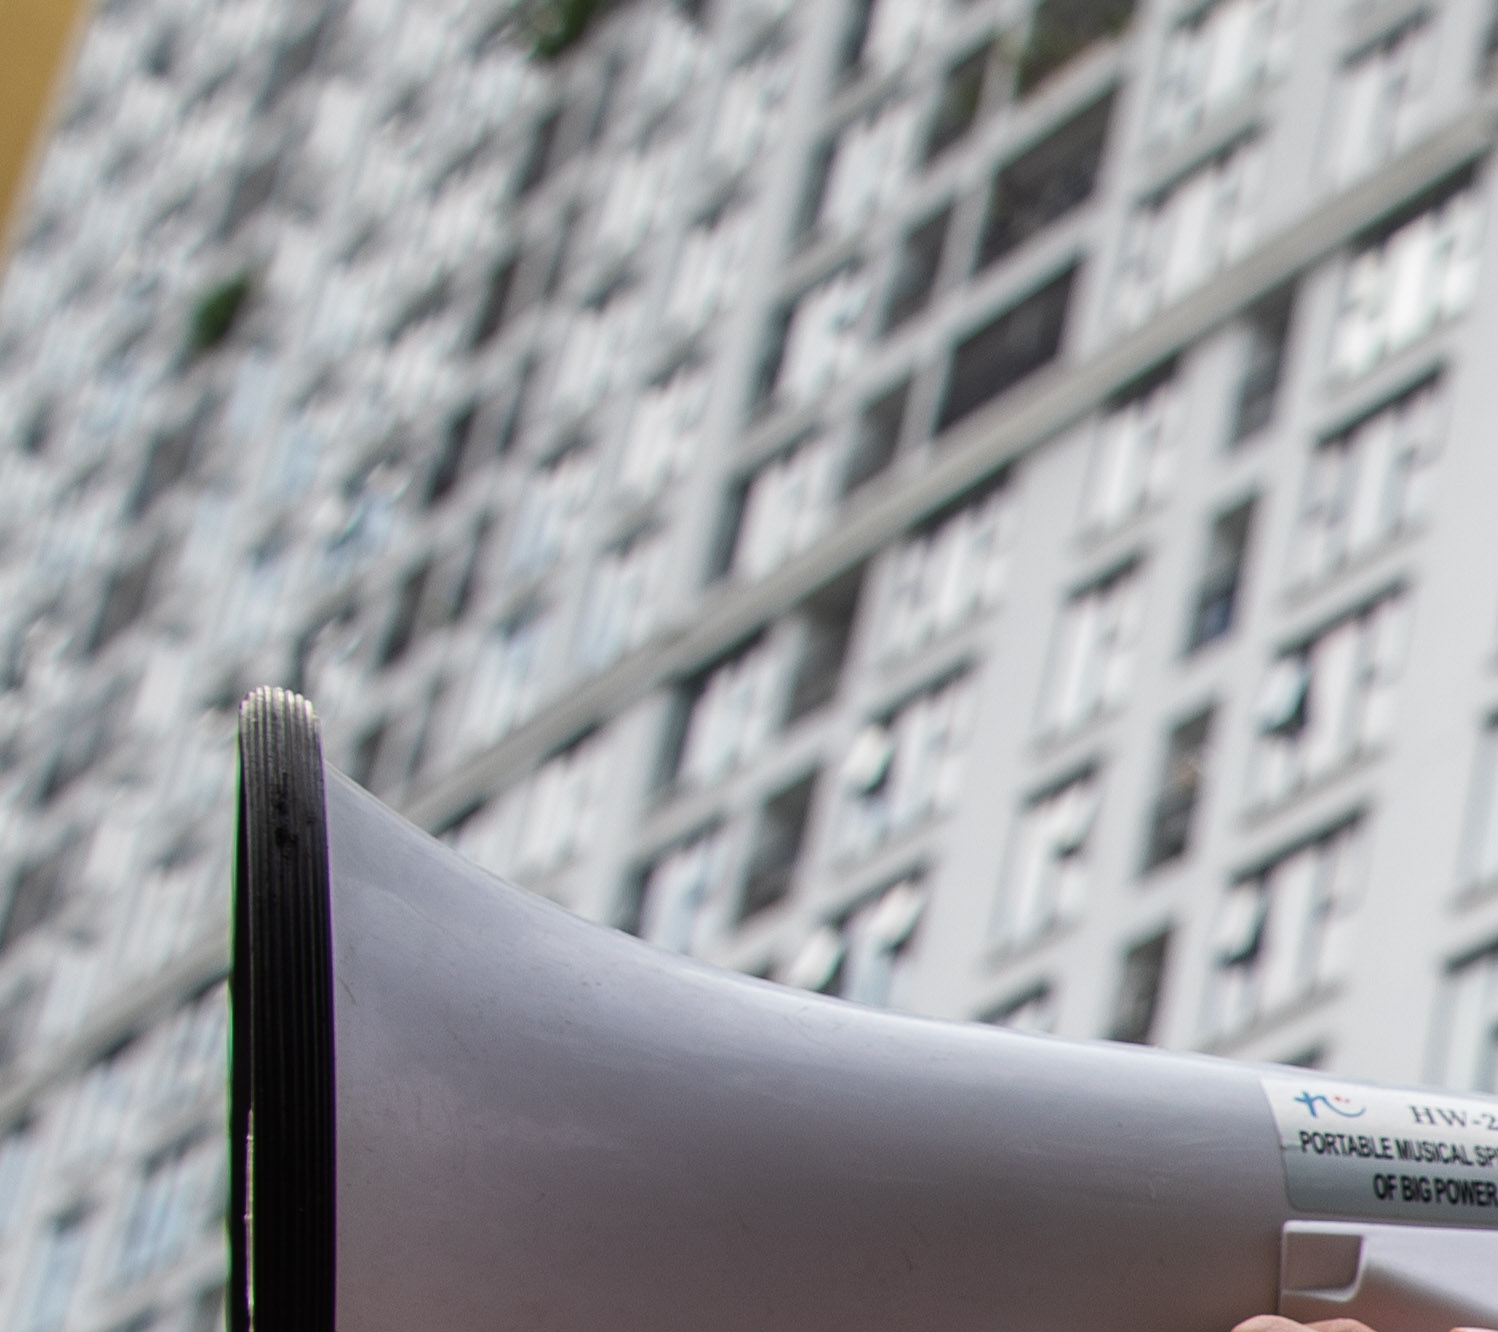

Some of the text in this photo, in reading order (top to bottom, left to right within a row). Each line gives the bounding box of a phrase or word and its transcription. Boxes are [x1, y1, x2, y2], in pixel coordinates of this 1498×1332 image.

[1299, 1130, 1393, 1160] PORTABLE
[1395, 1138, 1473, 1168] MUSICAL
[1374, 1173, 1398, 1199] OF
[1400, 1175, 1433, 1203] BIG
